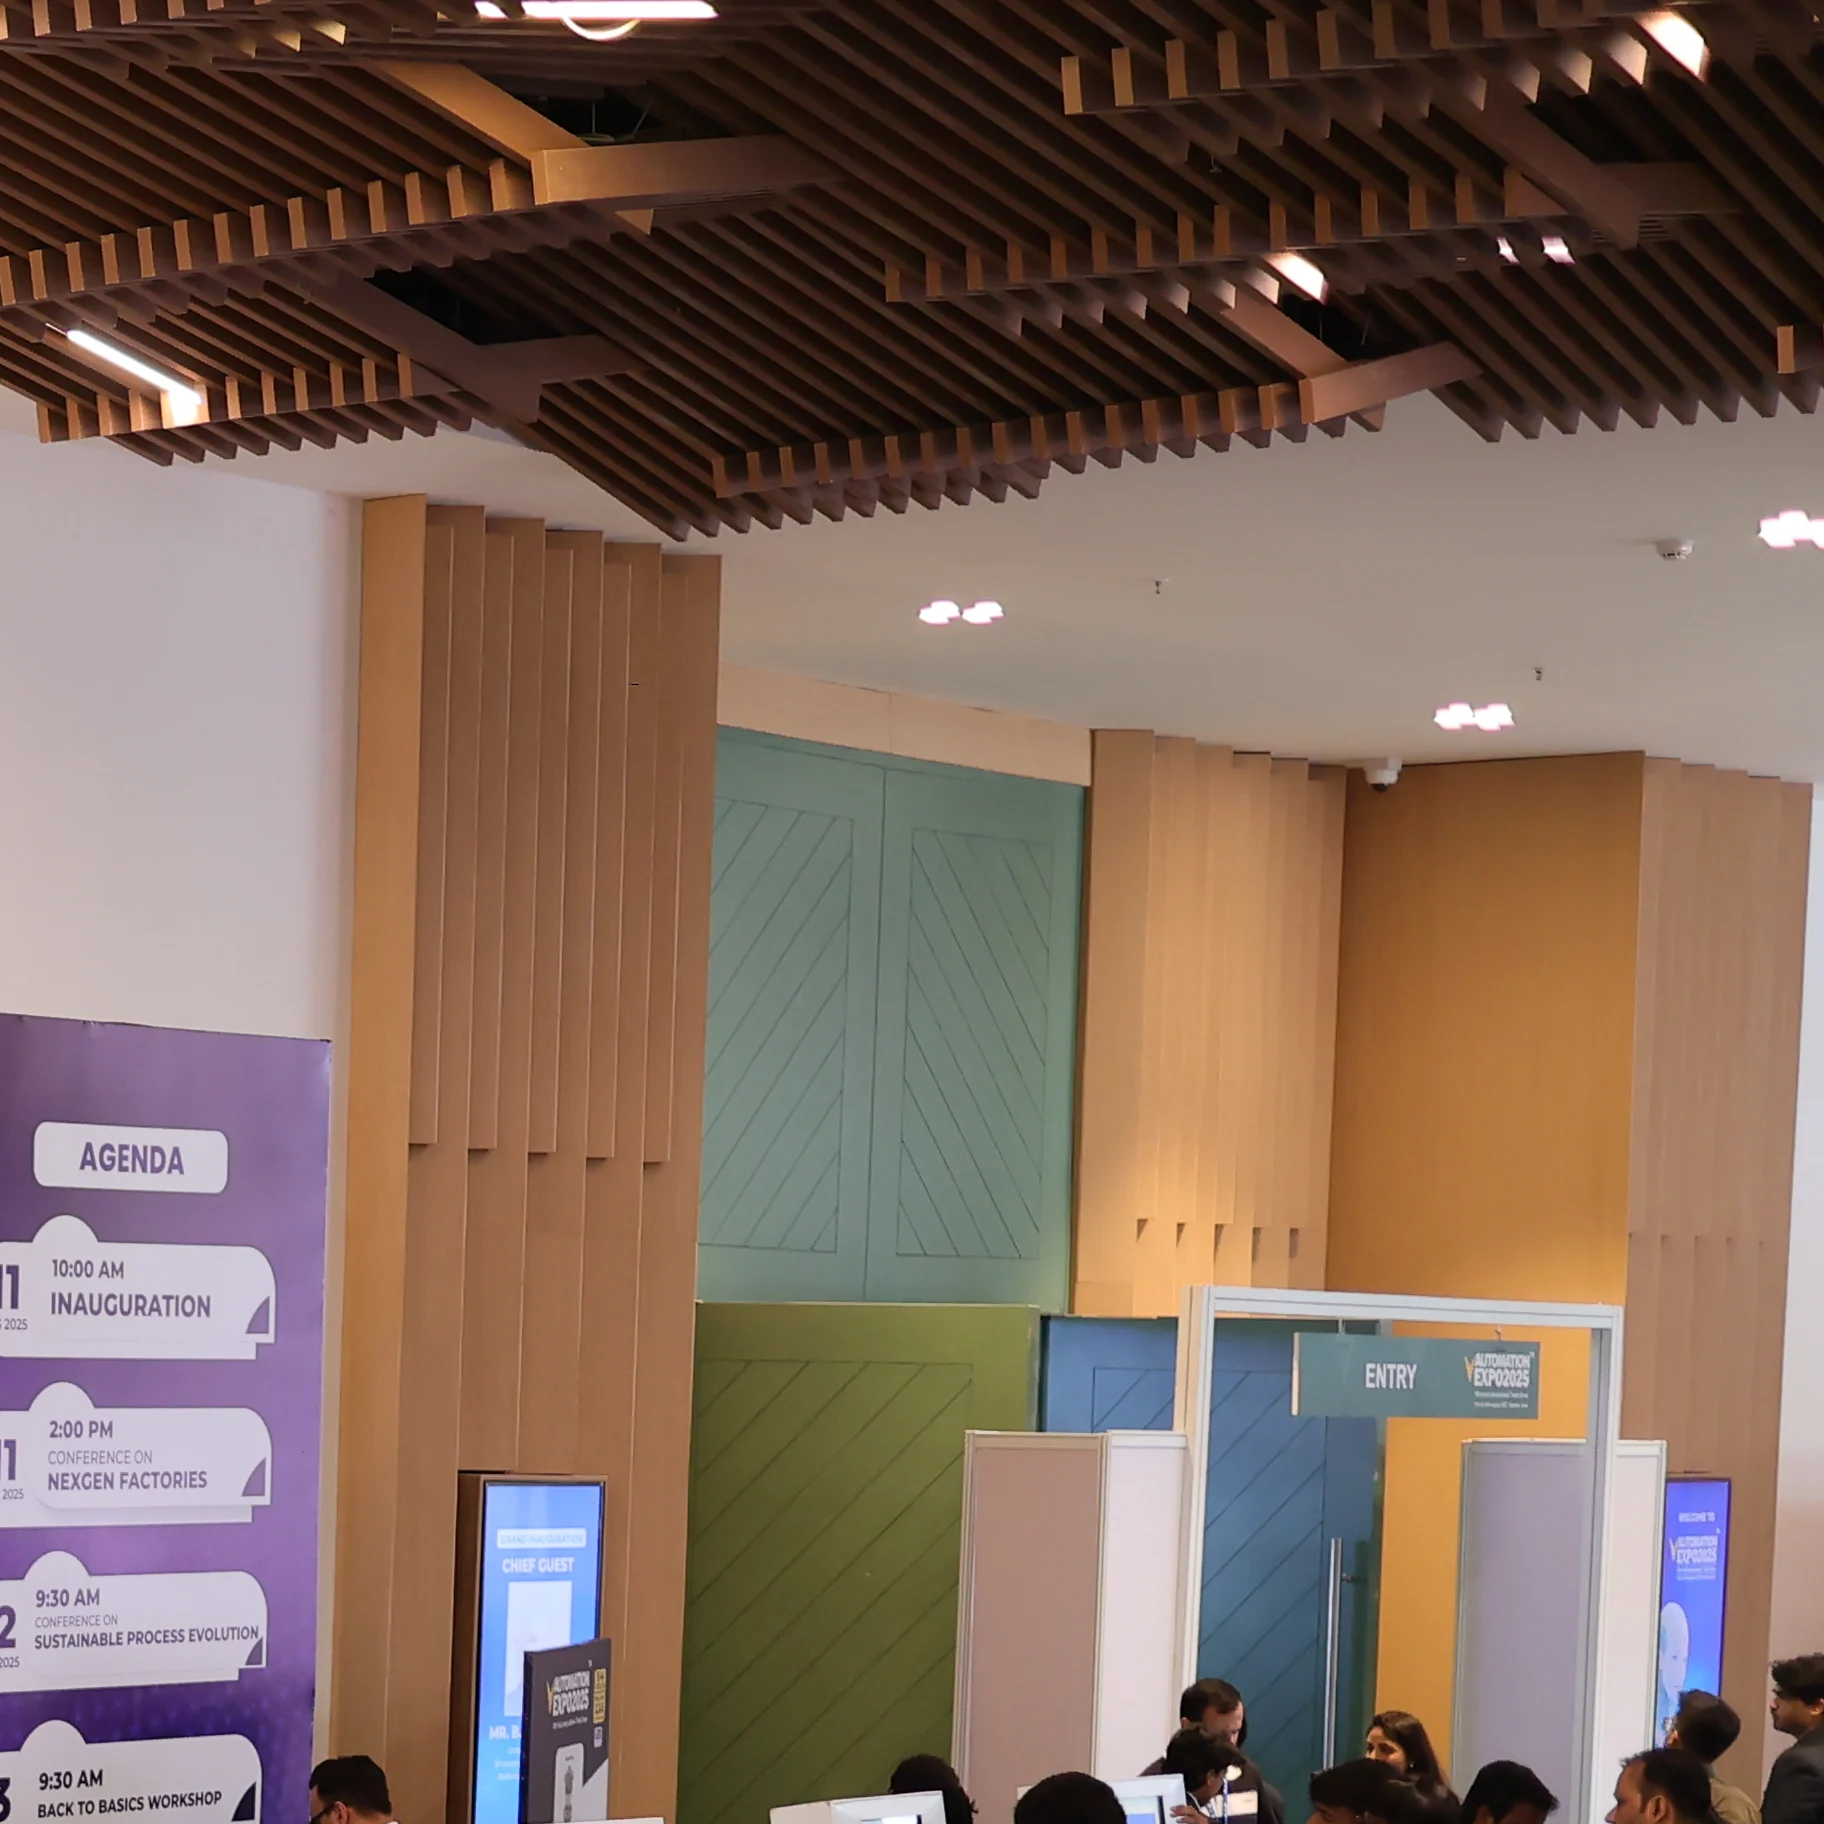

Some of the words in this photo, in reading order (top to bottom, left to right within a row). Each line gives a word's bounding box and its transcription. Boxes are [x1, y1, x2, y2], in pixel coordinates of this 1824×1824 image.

[79, 1141, 185, 1176] AGENDA
[52, 1258, 94, 1278] 10:00
[98, 1260, 125, 1279] AM
[50, 1291, 211, 1318] INAUGURATION
[4, 1318, 28, 1331] 2025
[1474, 1352, 1531, 1369] AUTOMATION
[1365, 1362, 1418, 1390] ENTRY
[1473, 1368, 1530, 1389] EXPO2025
[48, 1420, 84, 1439] 2:00
[88, 1420, 113, 1439] PM
[47, 1449, 131, 1465] CONFERENCE
[133, 1449, 153, 1464] ON
[47, 1471, 116, 1491] NEXGEN
[120, 1470, 208, 1490] FACTORIES
[3, 1488, 25, 1500] 2025
[502, 1557, 536, 1573] CHIEF
[538, 1556, 575, 1573] GUEST
[35, 1589, 70, 1609] 9:30
[74, 1588, 101, 1608] AM
[34, 1614, 101, 1629] CONFERENCE
[102, 1613, 119, 1627] ON
[34, 1630, 124, 1650] SUSTAINABLE
[127, 1628, 186, 1647] PROCESS
[188, 1625, 259, 1644] EVOLUTION
[38, 1771, 73, 1791] 9:30
[77, 1769, 104, 1789] AM
[37, 1802, 75, 1819] BACK
[77, 1800, 96, 1817] TO
[98, 1797, 144, 1816] BASICS
[148, 1790, 222, 1811] WORKSHOP
